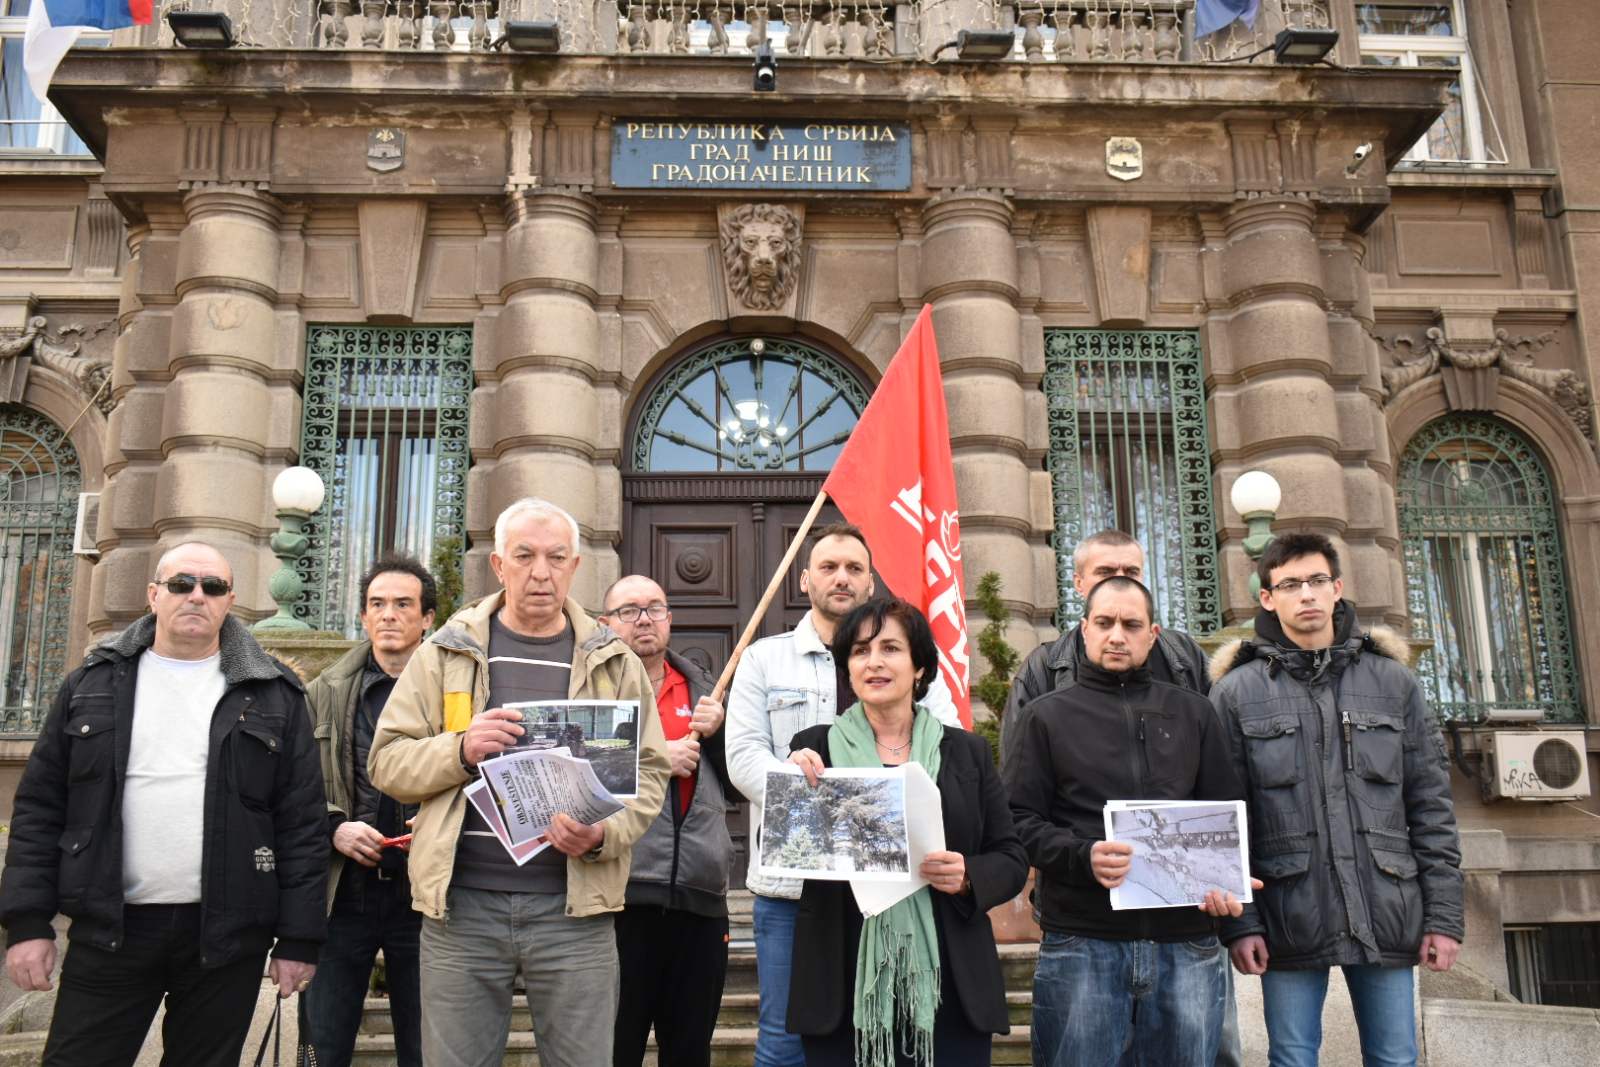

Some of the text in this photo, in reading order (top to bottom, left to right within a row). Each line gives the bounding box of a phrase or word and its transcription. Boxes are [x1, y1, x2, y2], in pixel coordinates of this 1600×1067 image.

[626, 122, 896, 142] РЕПУБЛИКА СРБИЈА
[690, 143, 832, 163] ГРАД НИШ
[652, 164, 872, 184] ГРАДОНАЧЕЛНИК
